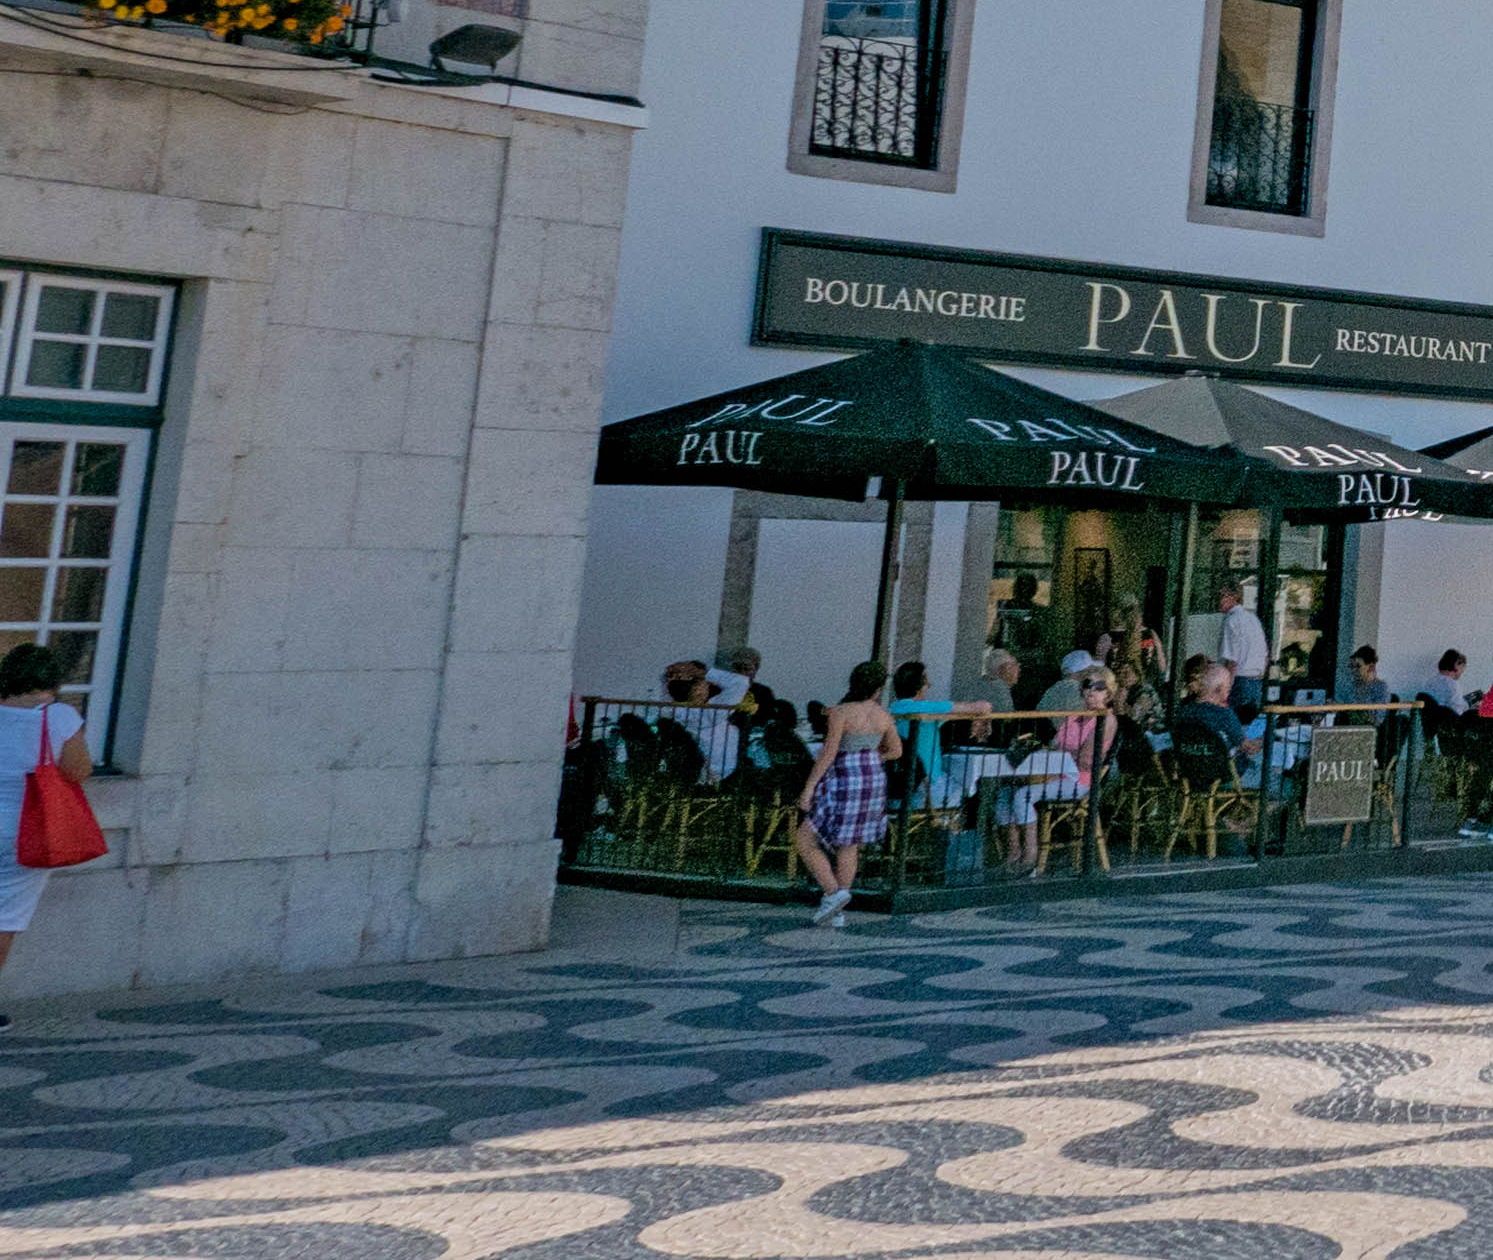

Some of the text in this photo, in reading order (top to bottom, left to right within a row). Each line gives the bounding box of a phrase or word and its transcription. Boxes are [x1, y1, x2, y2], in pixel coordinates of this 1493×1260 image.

[805, 277, 1491, 369] BOULANGERIE PAUL RESTAURANT
[676, 430, 764, 466] PAUL
[1263, 443, 1422, 473] PAUL
[1047, 451, 1145, 490] PAUL
[1337, 473, 1421, 507] PAUL
[1315, 760, 1368, 783] PAUL
